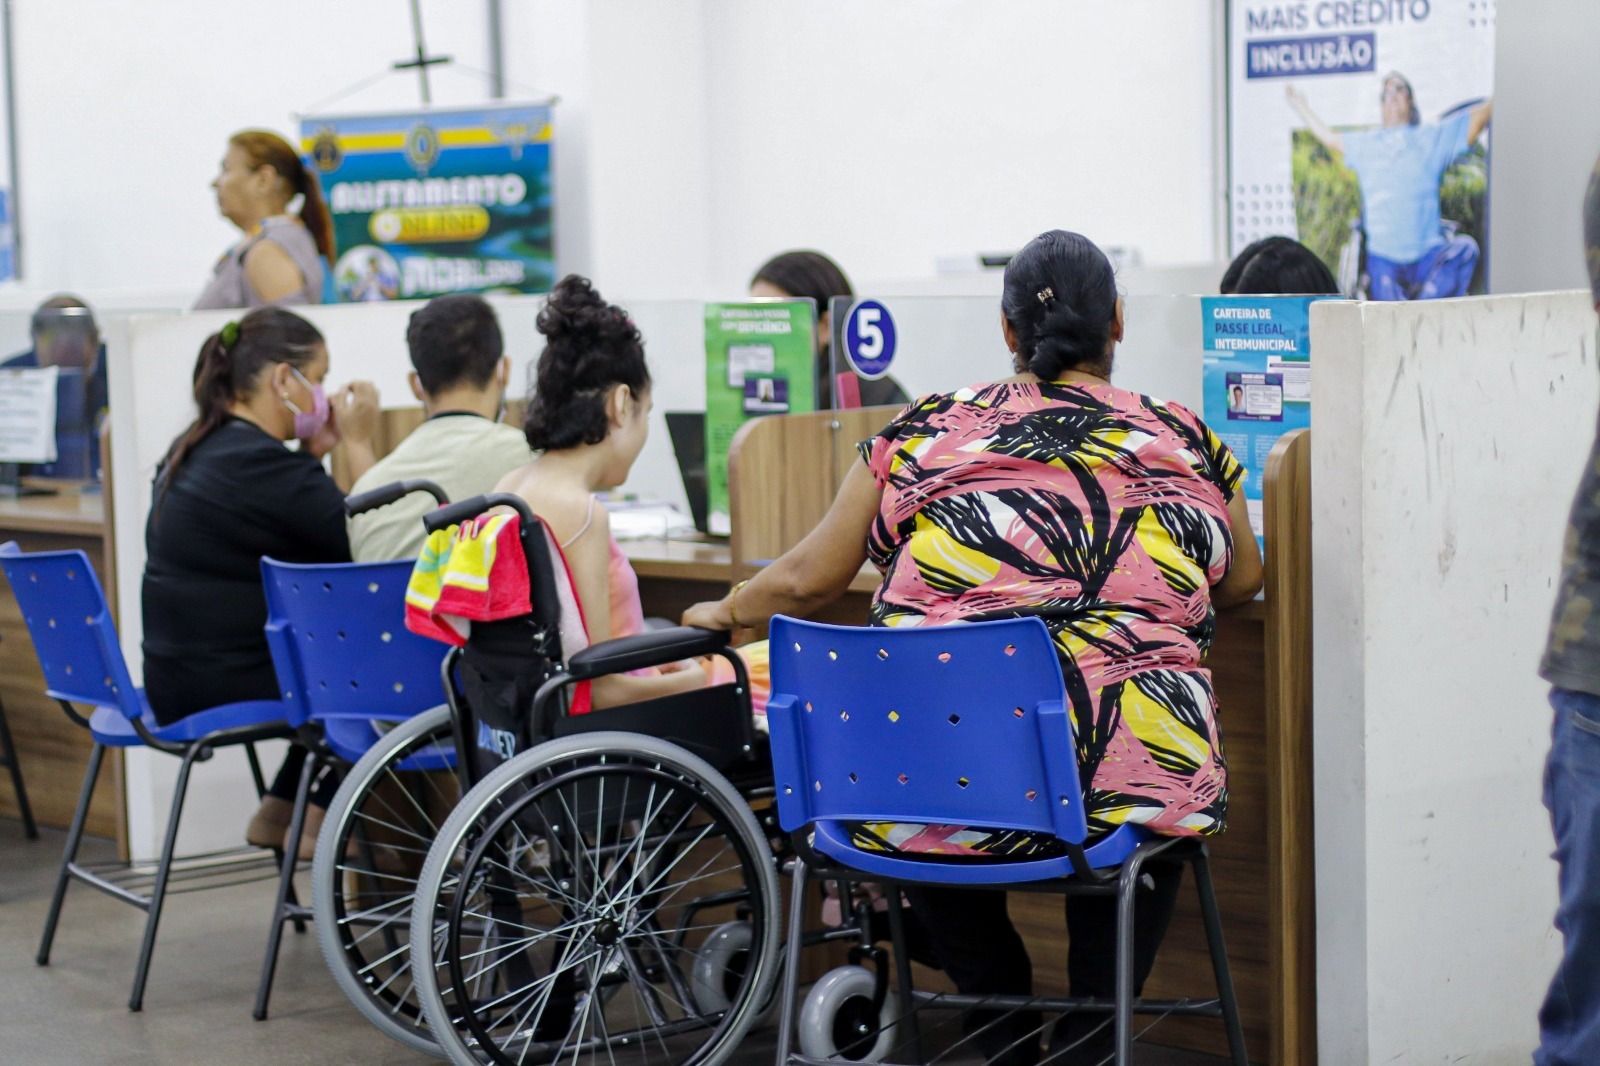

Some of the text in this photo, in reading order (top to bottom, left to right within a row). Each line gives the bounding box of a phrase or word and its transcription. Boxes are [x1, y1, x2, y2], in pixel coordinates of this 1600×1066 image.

[1247, 6, 1308, 32] MAIS
[1251, 35, 1373, 72] INCLUSÃO
[1213, 308, 1272, 320] CARTEIRA DE
[856, 308, 884, 359] 5
[1215, 322, 1285, 335] PASSE LEGAL
[1215, 338, 1297, 351] INTERMUNICIPAL
